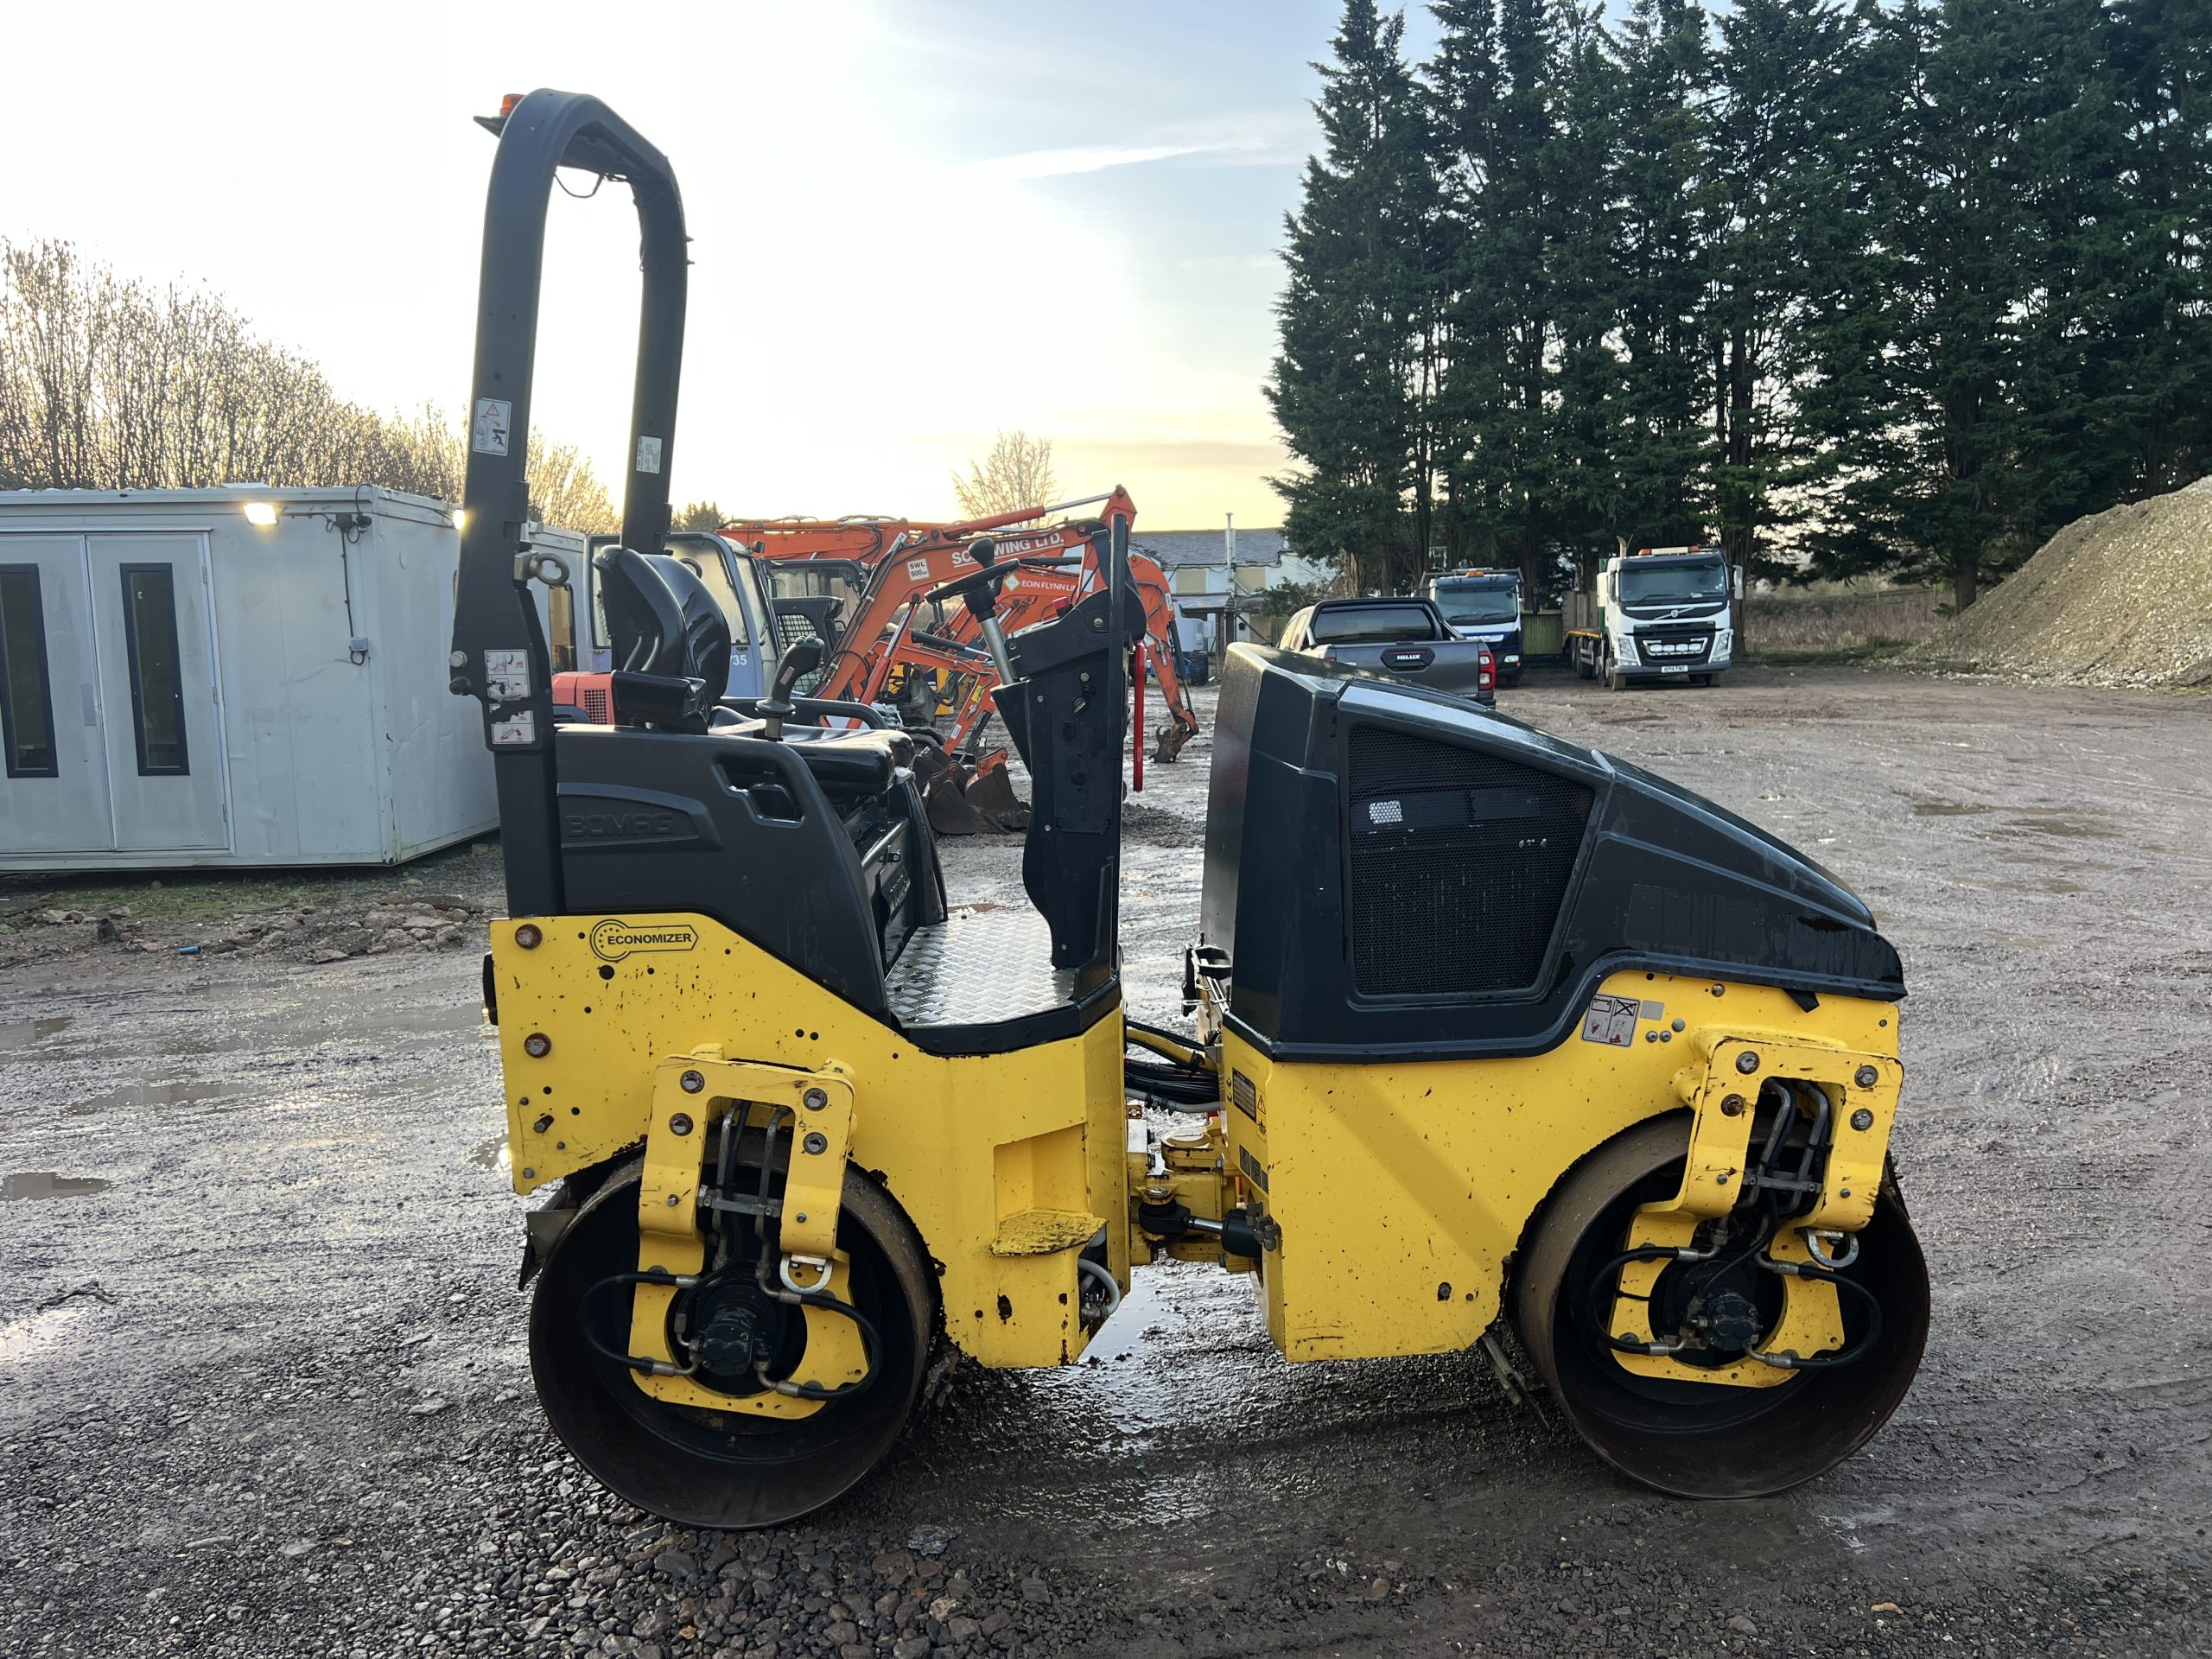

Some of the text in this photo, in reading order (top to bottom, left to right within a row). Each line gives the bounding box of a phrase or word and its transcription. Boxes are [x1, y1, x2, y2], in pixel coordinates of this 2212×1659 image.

[1021, 580, 1039, 588] EOIN
[1041, 582, 1065, 591] FLYNN
[607, 933, 691, 945] ECONOMIZER
